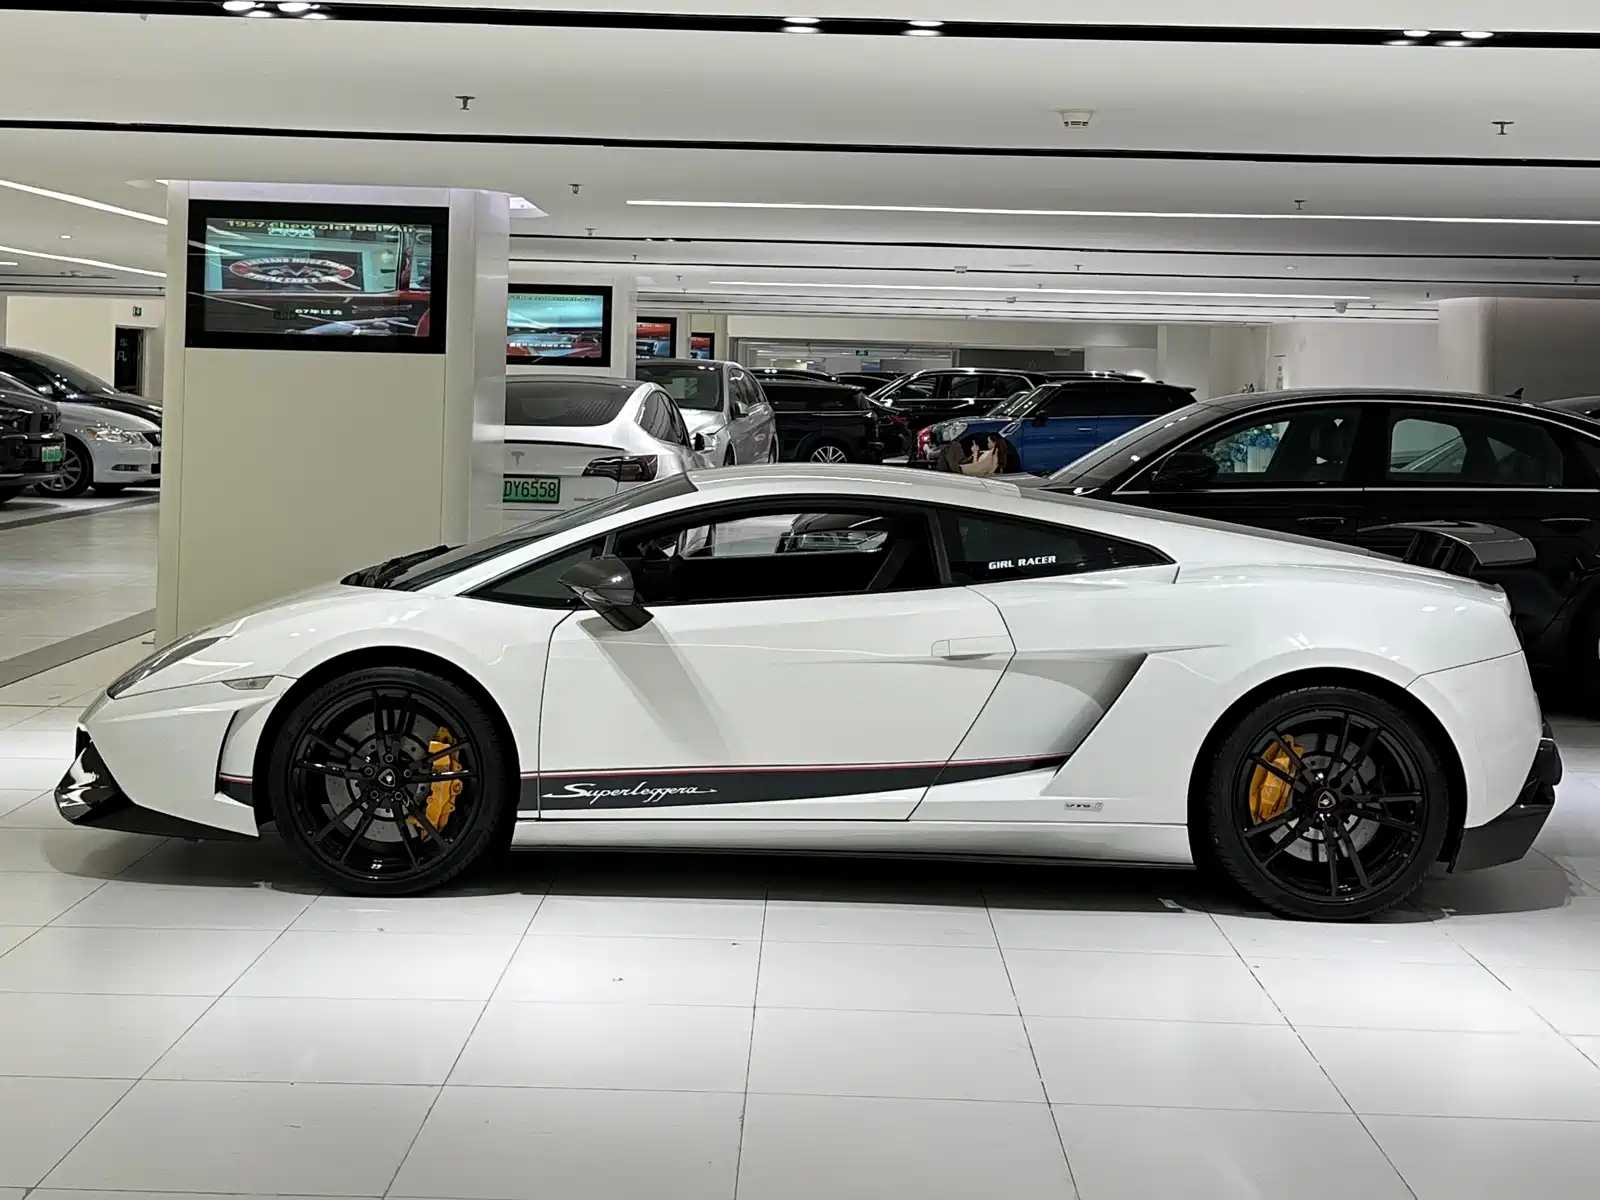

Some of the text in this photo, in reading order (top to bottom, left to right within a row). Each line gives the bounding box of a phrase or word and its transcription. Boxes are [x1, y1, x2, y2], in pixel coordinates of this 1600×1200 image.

[226, 220, 266, 228] 1957
[269, 221, 354, 231] Chevrolet
[503, 481, 557, 498] DY6558
[988, 555, 1057, 570] GIRL RACER
[541, 781, 718, 805] Superleggera
